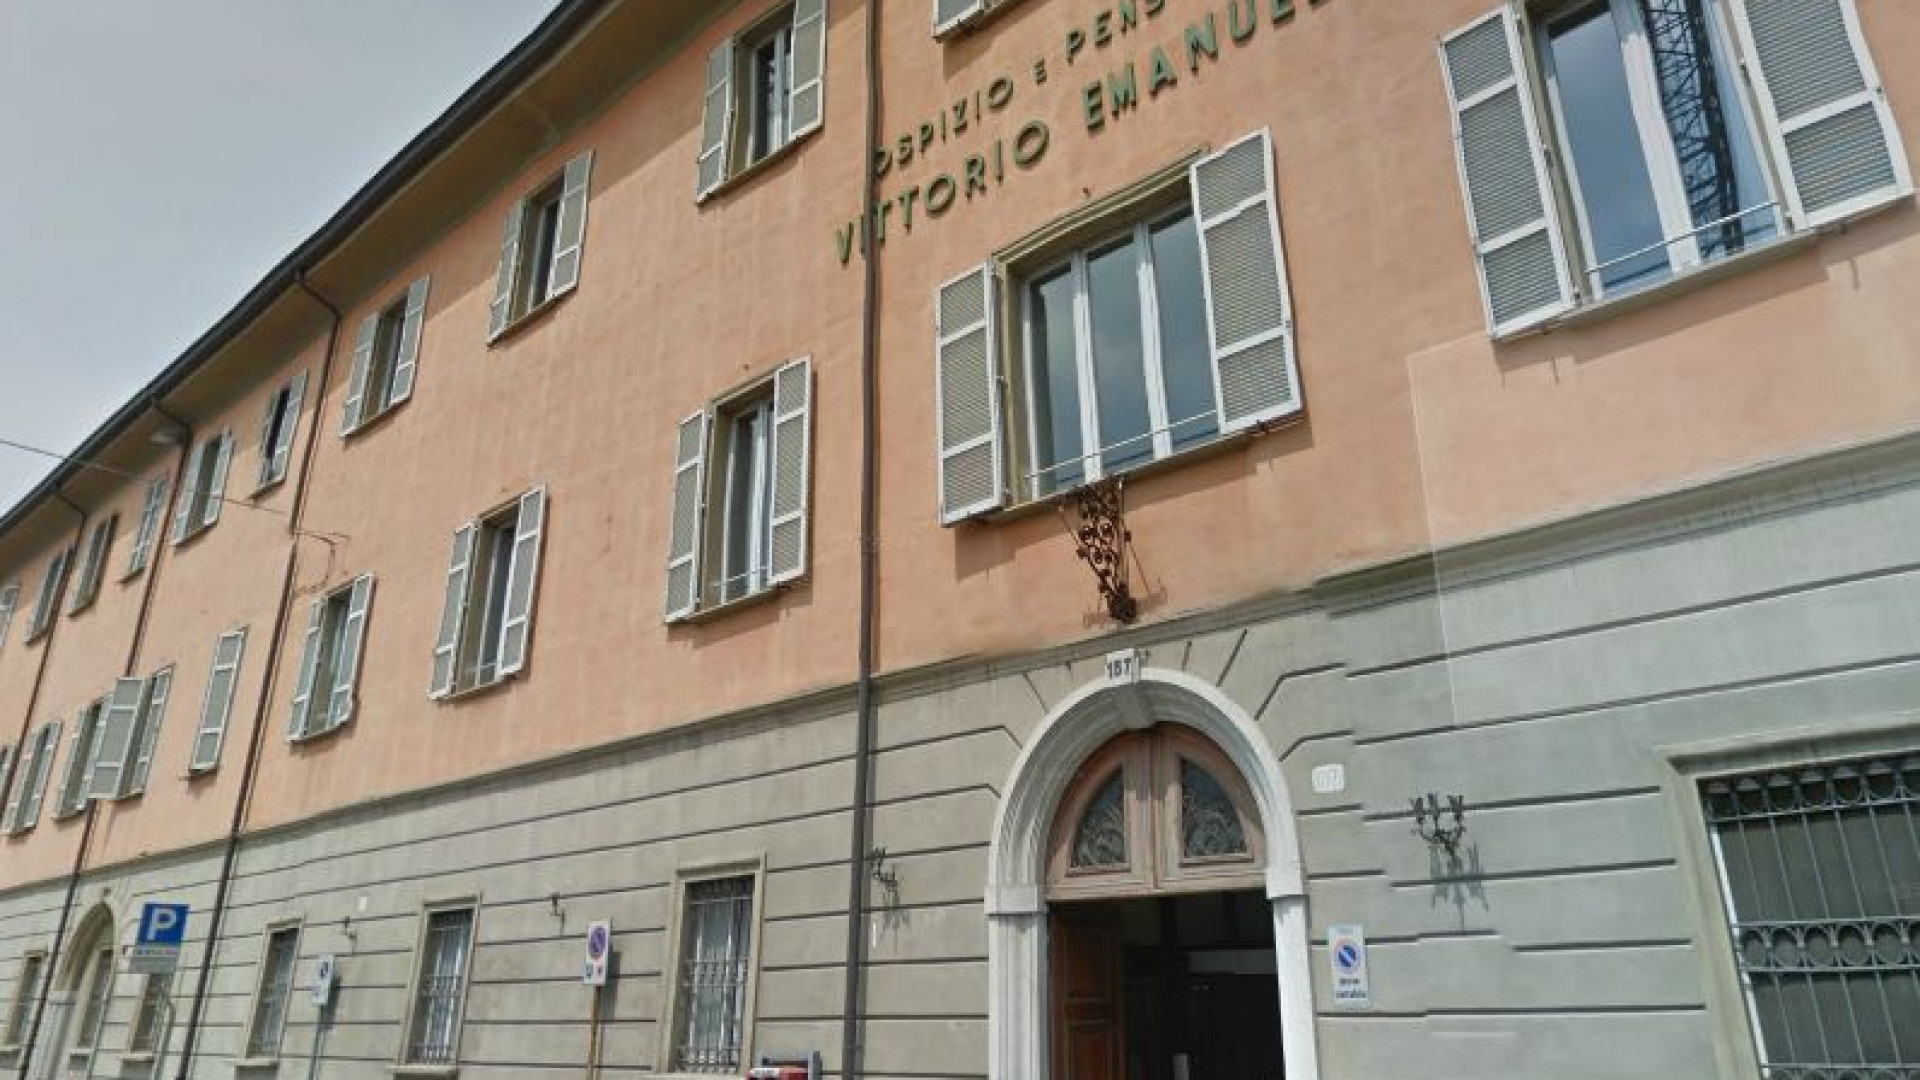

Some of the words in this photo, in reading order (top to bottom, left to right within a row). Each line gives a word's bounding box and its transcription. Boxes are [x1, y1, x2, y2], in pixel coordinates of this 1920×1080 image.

[873, 75, 1014, 182] OSPIZIO
[1033, 58, 1048, 86] E
[835, 120, 1051, 268] VITTORIO
[146, 907, 178, 941] P
